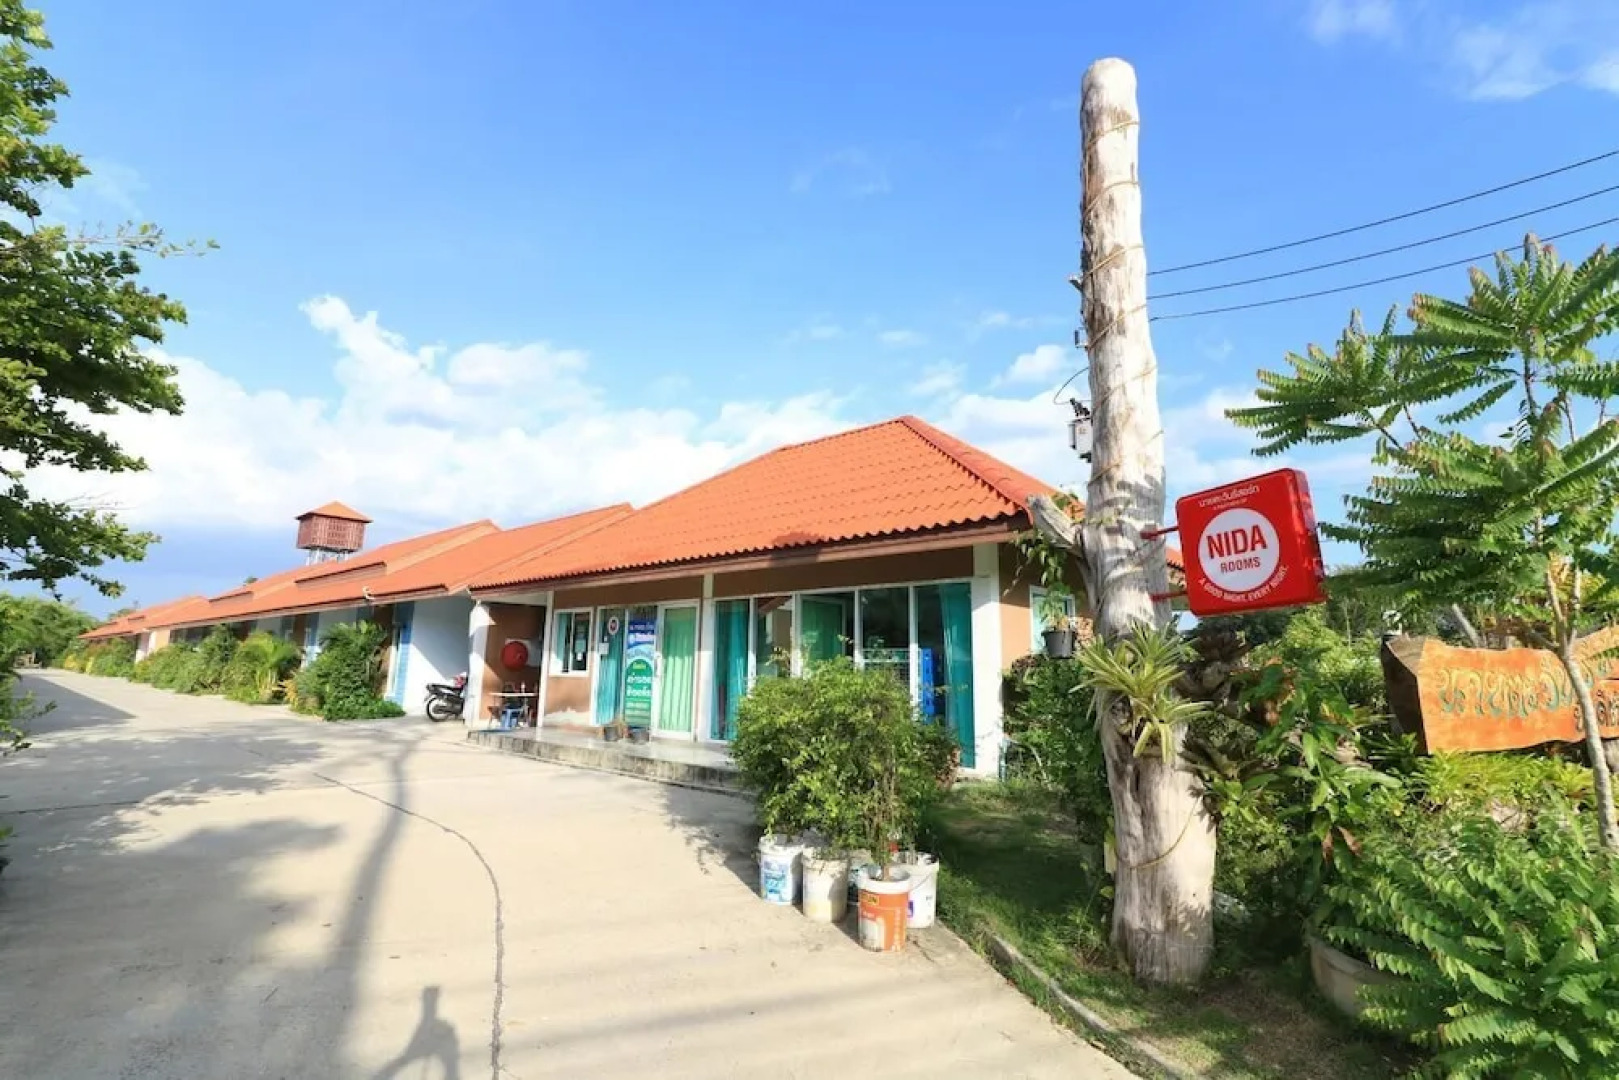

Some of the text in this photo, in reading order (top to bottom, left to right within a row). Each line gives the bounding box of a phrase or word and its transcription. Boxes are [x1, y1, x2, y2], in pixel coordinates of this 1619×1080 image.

[1207, 525, 1267, 559] NIDA
[1220, 558, 1260, 574] ROOMS
[1248, 585, 1272, 602] EVERY
